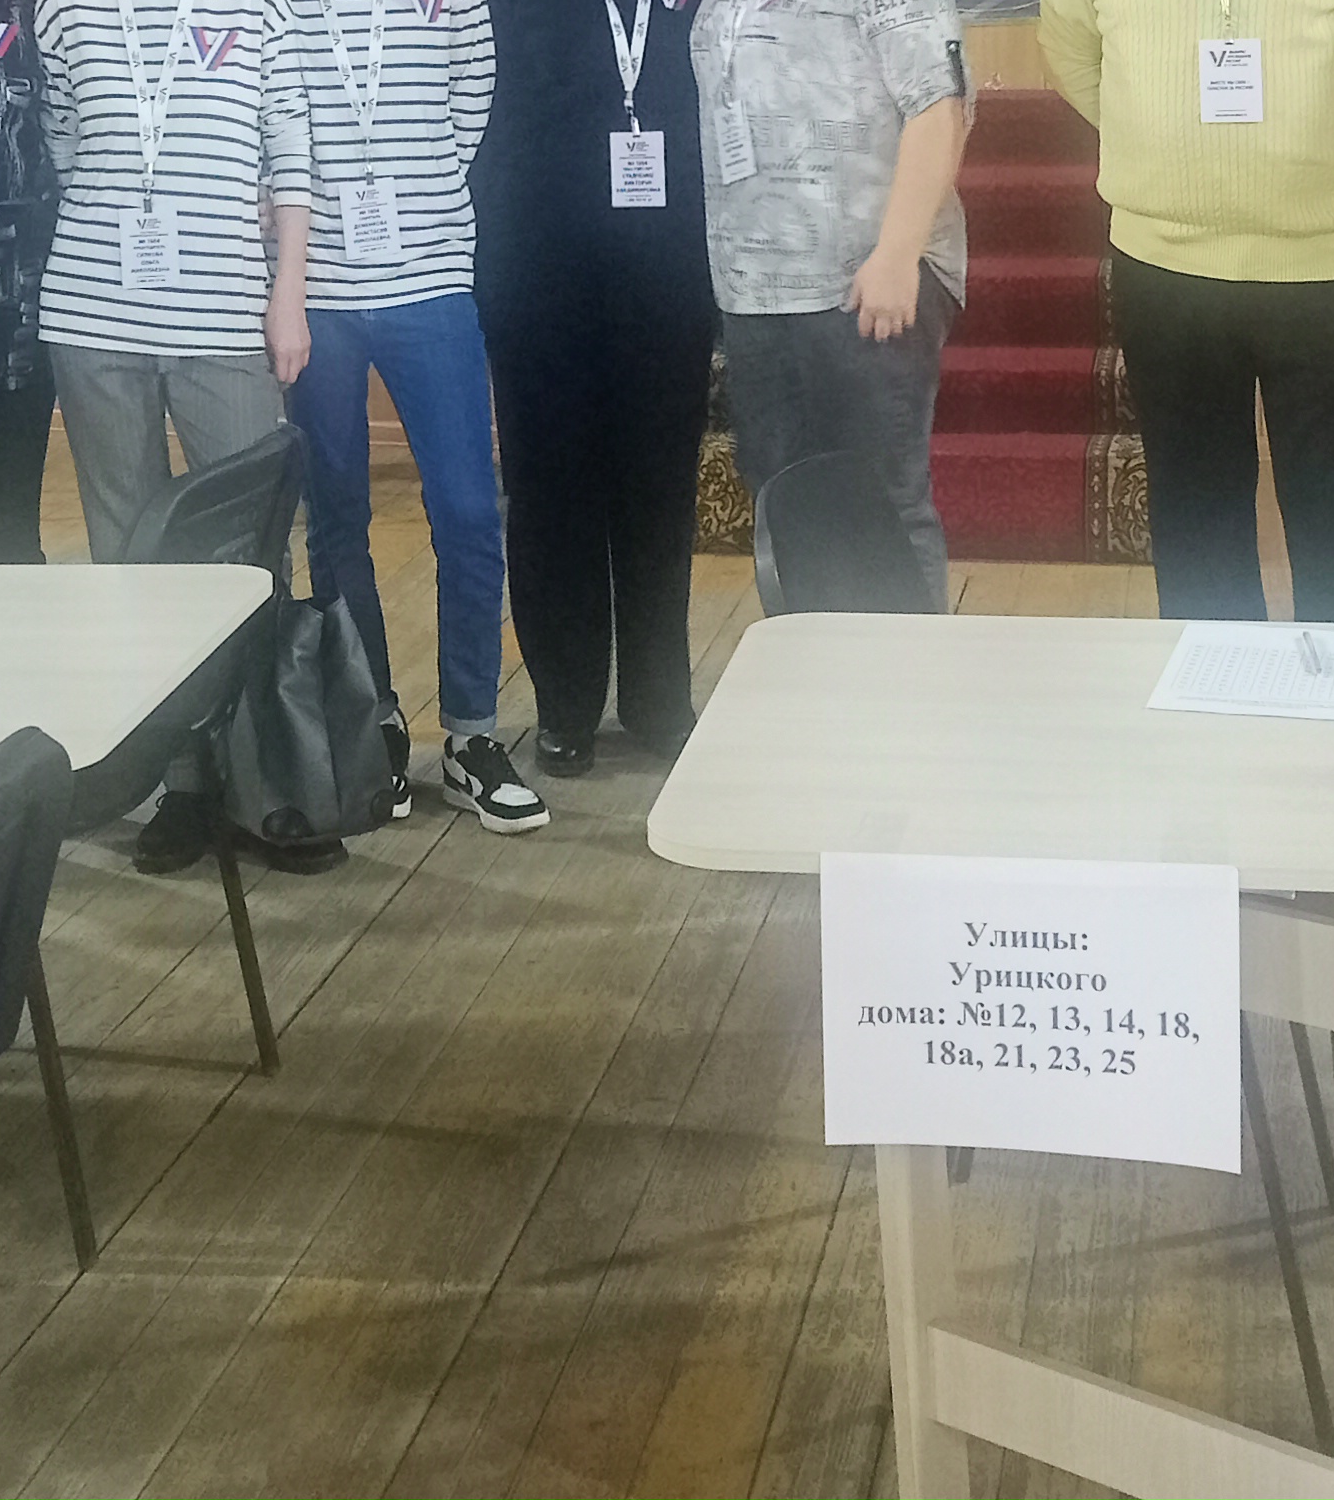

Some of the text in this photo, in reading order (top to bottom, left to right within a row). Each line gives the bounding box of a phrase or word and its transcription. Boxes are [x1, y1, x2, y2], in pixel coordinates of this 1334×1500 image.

[963, 921, 1088, 953] Улицы:
[947, 961, 1107, 994] Урицкого
[857, 1001, 1200, 1045] дома: №12, 13, 14, 18,
[923, 1039, 1136, 1078] 18а, 21, 23, 25
